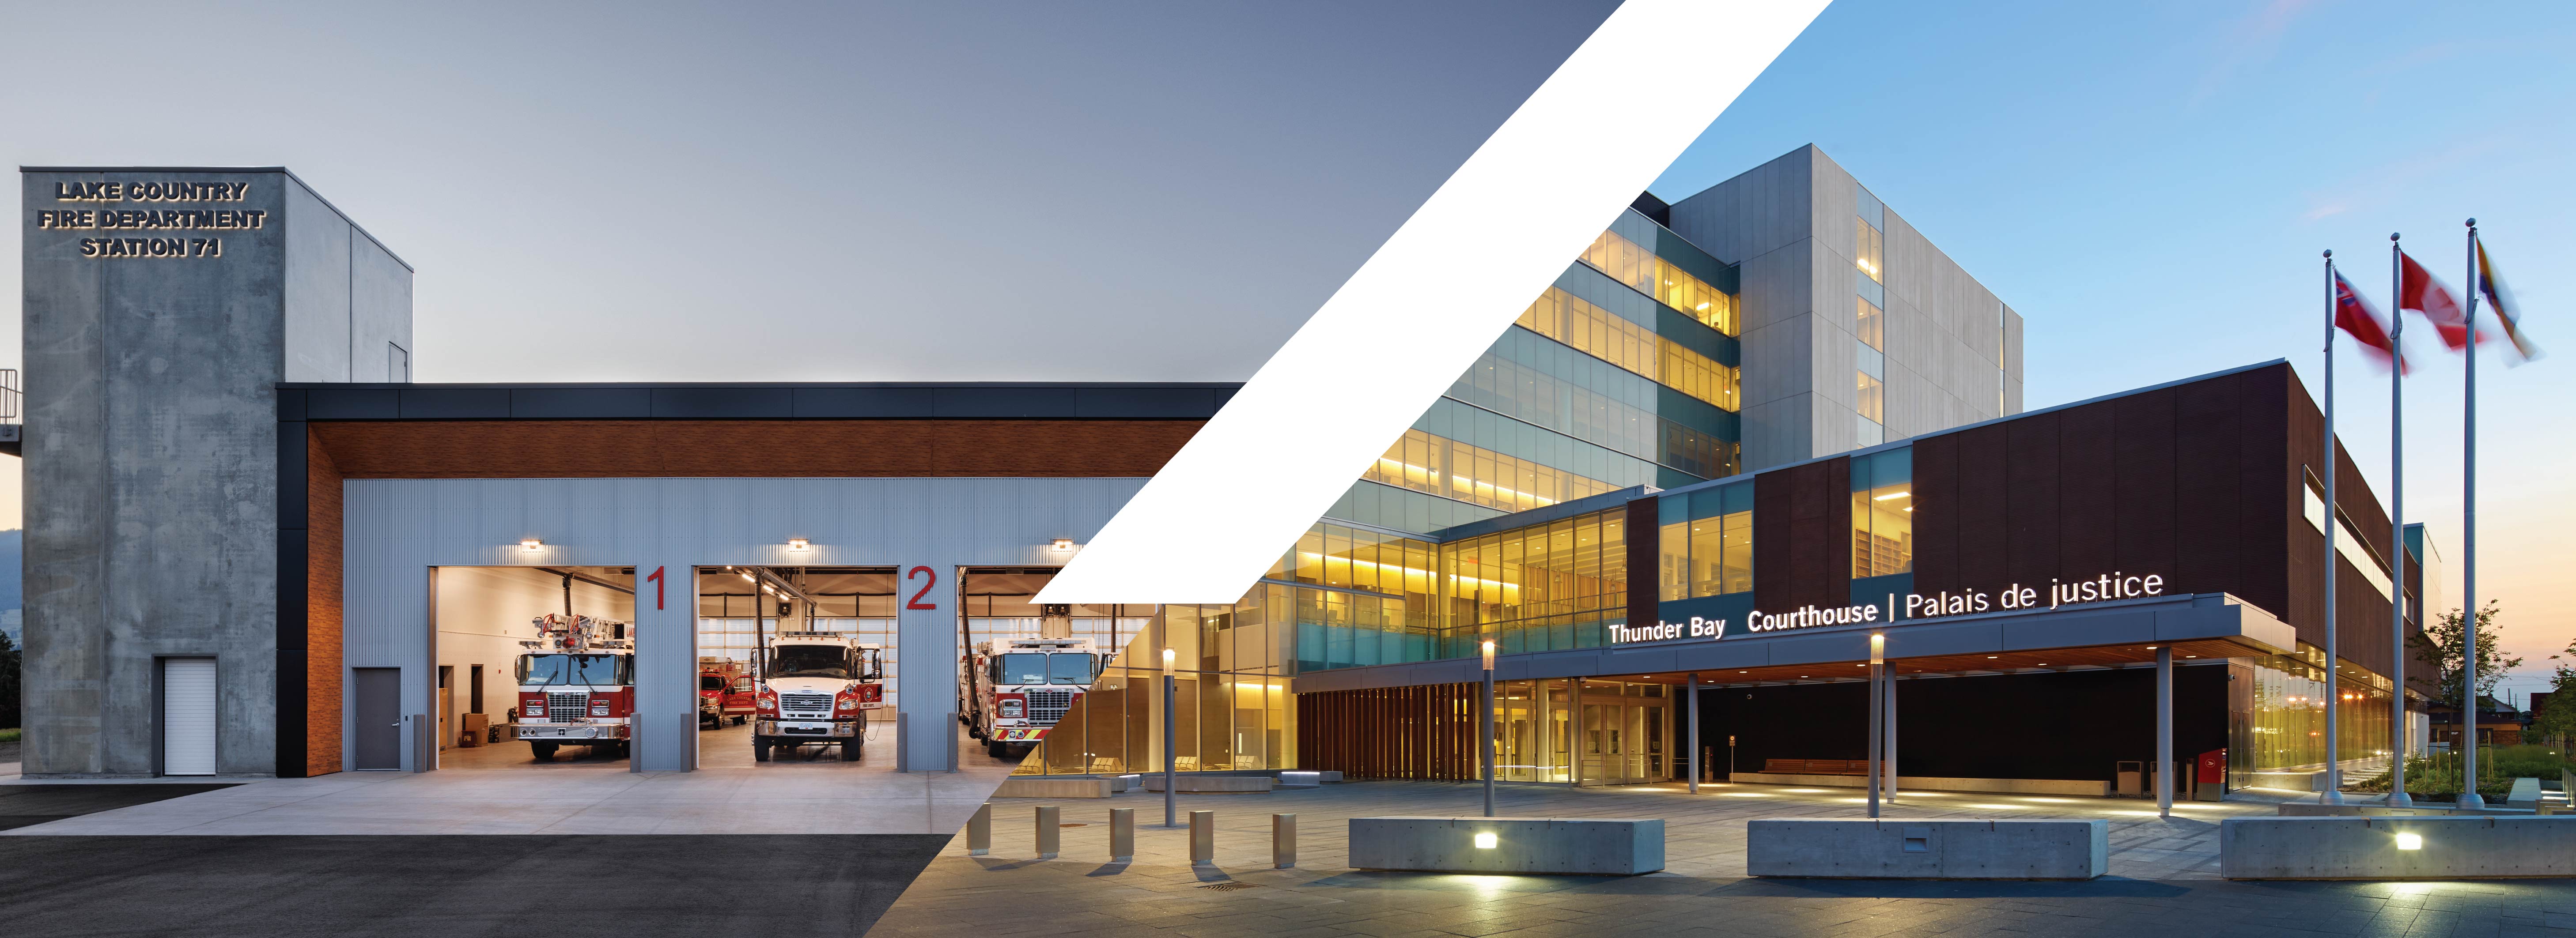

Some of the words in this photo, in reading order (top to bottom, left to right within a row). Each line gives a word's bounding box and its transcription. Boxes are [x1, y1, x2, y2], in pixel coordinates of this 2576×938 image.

[55, 182, 121, 200] LAKE
[127, 182, 247, 200] COUNTRY
[37, 210, 94, 227] FIRE
[100, 210, 265, 227] DEPARTMENT
[79, 238, 185, 256] STATION
[192, 238, 219, 256] 71
[647, 566, 664, 610] 1
[907, 565, 936, 610] 2
[1609, 620, 1684, 644] Thunder
[1691, 616, 1727, 639] Bay
[1748, 604, 1878, 632] Courthouse
[1906, 588, 1990, 618] Palais
[2001, 583, 2036, 609] de
[2050, 571, 2163, 610] justice
